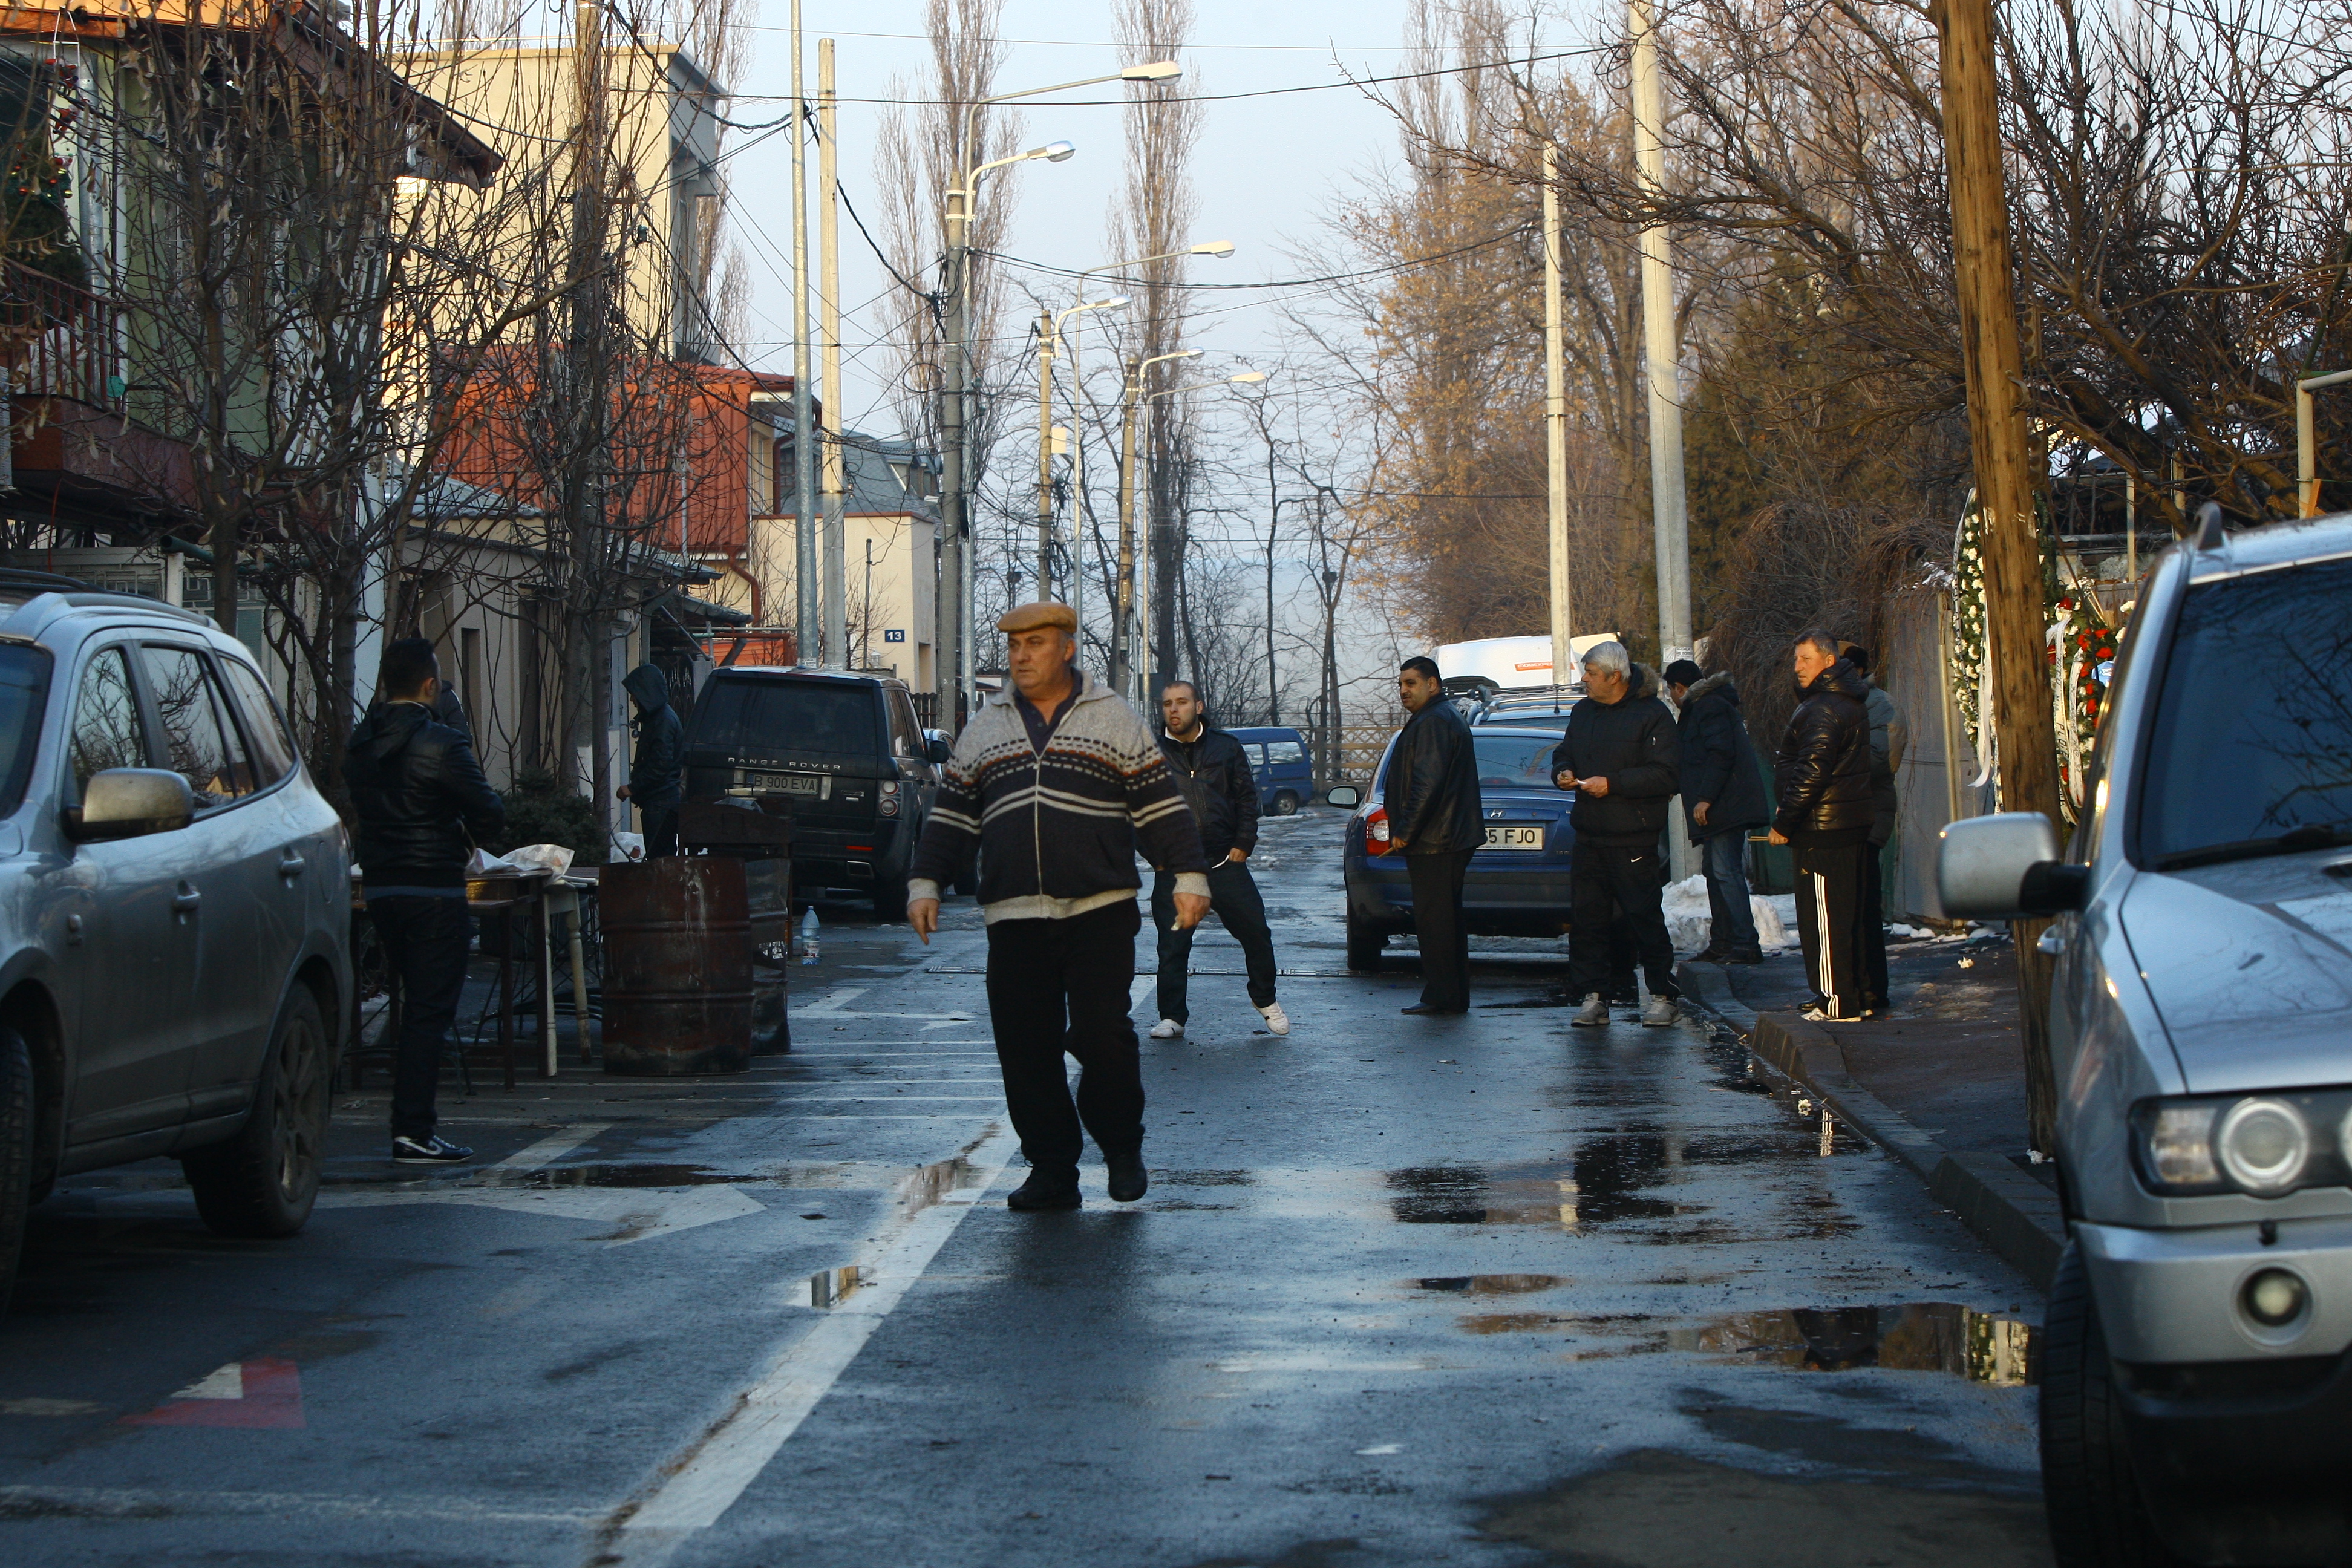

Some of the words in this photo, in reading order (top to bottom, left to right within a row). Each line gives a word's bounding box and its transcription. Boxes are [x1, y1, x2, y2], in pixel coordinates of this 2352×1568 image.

[887, 632, 901, 640] 13
[789, 762, 840, 770] ROVER
[754, 776, 763, 786] B
[767, 777, 788, 789] 900
[791, 779, 815, 791] EVA
[1485, 829, 1498, 844] 5
[1504, 829, 1535, 844] FJO
